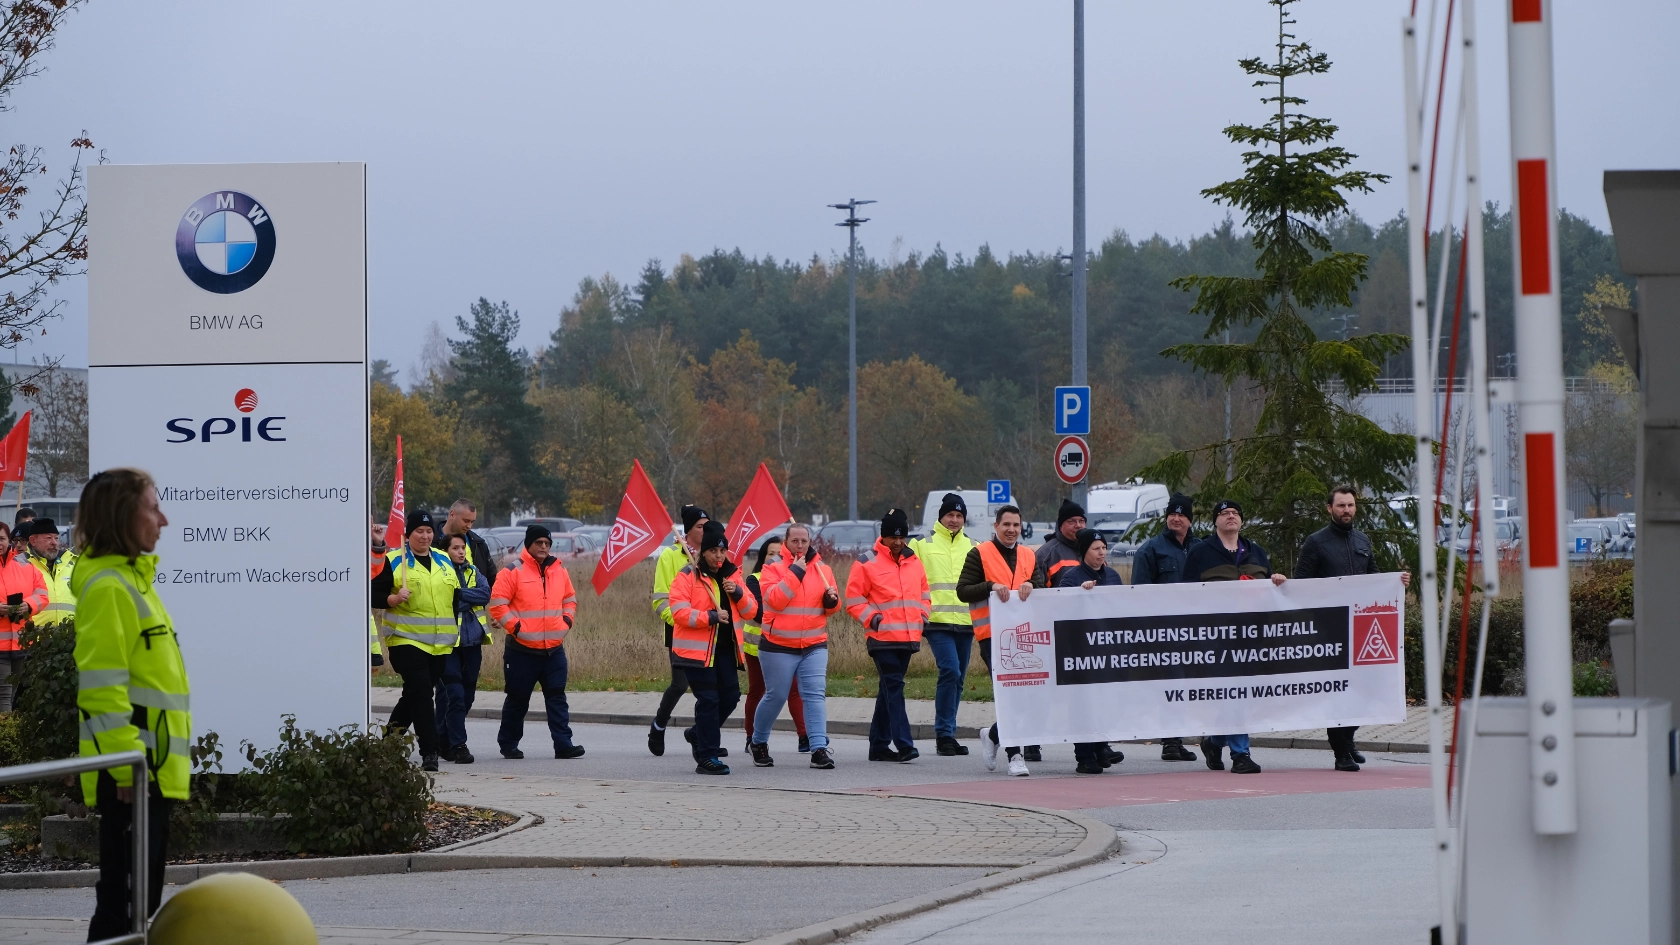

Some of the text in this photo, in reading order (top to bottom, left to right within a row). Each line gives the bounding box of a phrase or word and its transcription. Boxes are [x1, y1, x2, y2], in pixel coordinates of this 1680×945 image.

[184, 193, 269, 228] BMW
[190, 314, 263, 330] BMW AG
[1063, 393, 1081, 429] P
[166, 416, 287, 443] SPIE
[155, 485, 349, 502] Mitarbeiterversicherung
[991, 483, 1003, 501] P
[183, 526, 271, 542] BMW BKK
[1581, 538, 1587, 546] P
[173, 569, 241, 584] Zentrum
[246, 567, 350, 583] Wackersdorf
[1022, 632, 1049, 643] METALL
[1086, 620, 1317, 646] VERTRAUENSLEUTE IG METALL
[1063, 642, 1343, 671] BMW REGENSBURG / WACKERSDORF
[1164, 680, 1349, 702] VK BEREICH WACKERSDORF
